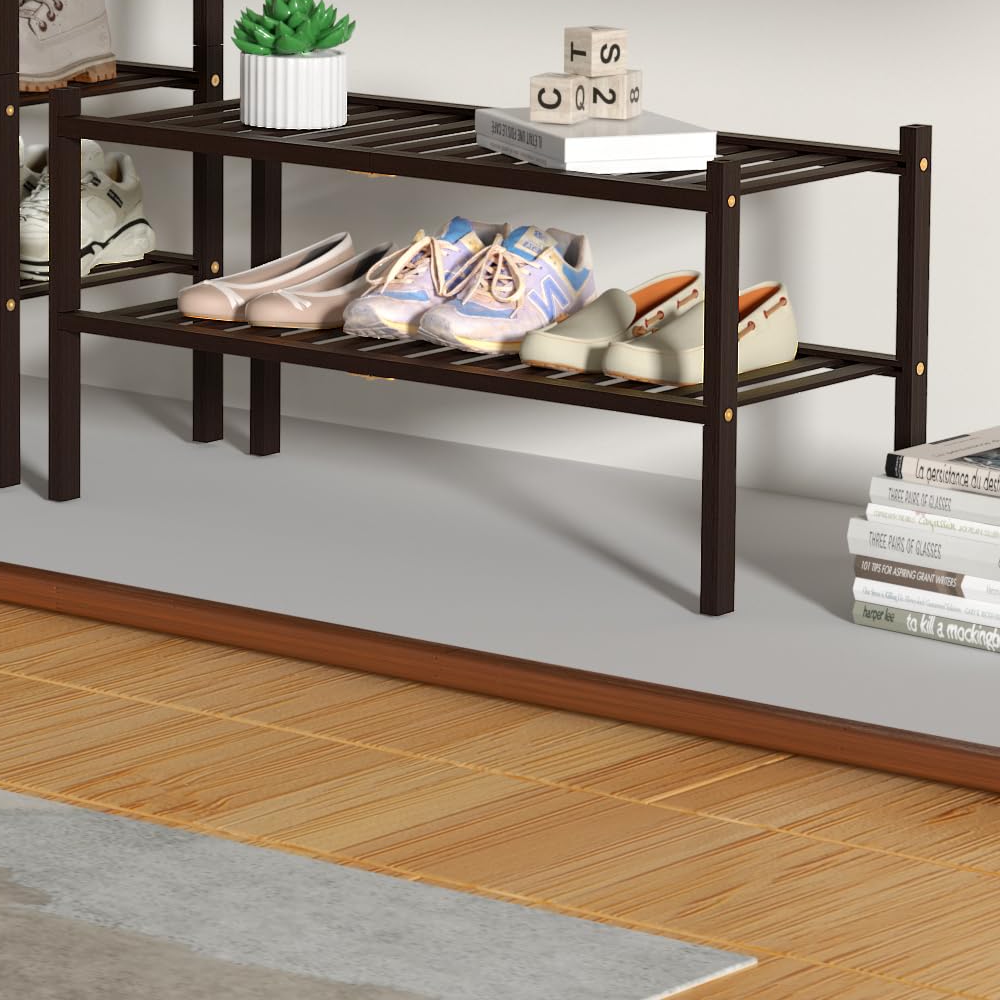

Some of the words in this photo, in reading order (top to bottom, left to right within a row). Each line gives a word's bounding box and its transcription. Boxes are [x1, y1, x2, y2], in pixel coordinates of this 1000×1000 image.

[570, 41, 587, 62] T
[600, 43, 621, 64] S
[537, 87, 562, 110] C
[575, 85, 586, 111] Q
[592, 87, 617, 105] 2
[629, 86, 640, 103] 8
[926, 464, 969, 488] persistance
[971, 468, 981, 489] du
[888, 487, 904, 504] THREE
[905, 490, 920, 506] PAIRS
[921, 492, 929, 507] OF
[929, 493, 952, 512] GLASSES
[869, 531, 887, 549] THREE
[888, 535, 905, 553] PAIRS
[906, 538, 915, 554] OF
[915, 539, 942, 559] GLASSES
[861, 560, 870, 571] 101
[871, 562, 881, 573] TIPS
[881, 563, 893, 575] FOR
[892, 566, 917, 580] ASPIRING
[917, 570, 936, 583] GRANT
[935, 574, 957, 587] WRITERS
[862, 605, 883, 622] harper
[884, 607, 895, 622] lee
[906, 613, 917, 632] to
[920, 613, 936, 635] kill
[937, 622, 944, 638] a
